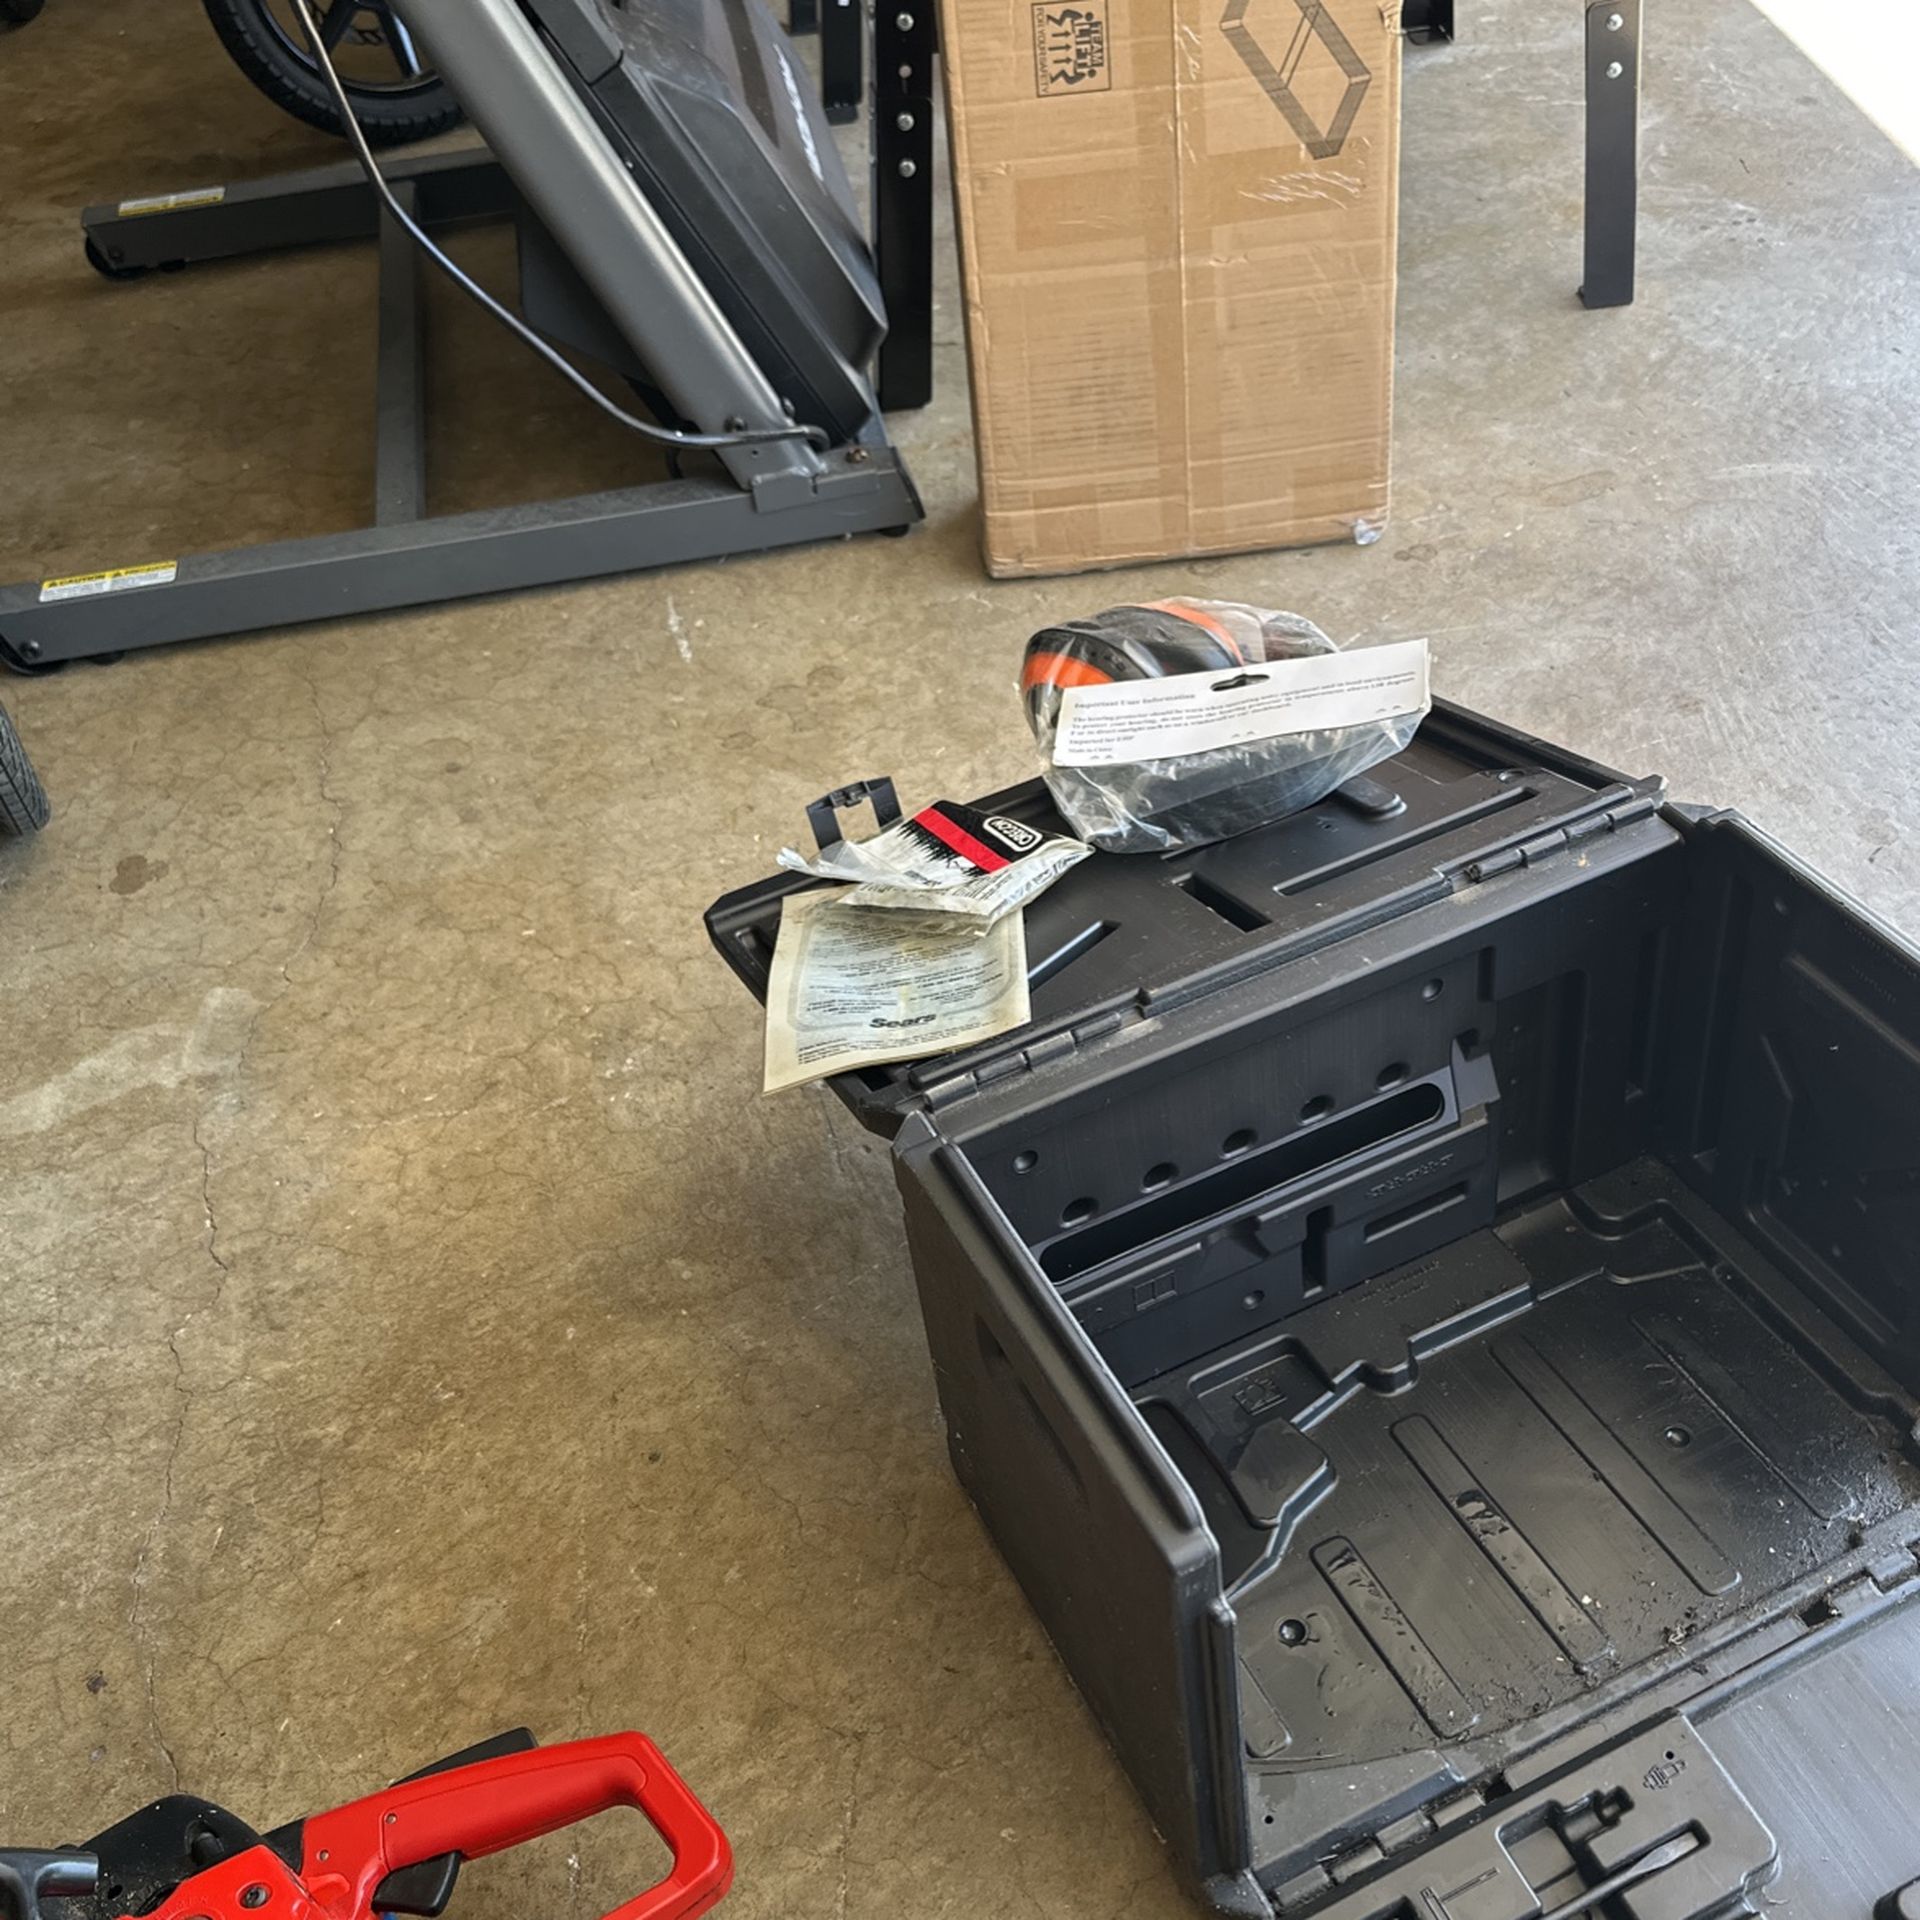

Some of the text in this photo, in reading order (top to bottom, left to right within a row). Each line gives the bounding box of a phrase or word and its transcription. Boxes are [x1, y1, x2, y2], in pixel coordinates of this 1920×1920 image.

[1036, 7, 1049, 93] FOR YOUR SAFETY
[1075, 25, 1091, 66] LIFT
[1091, 24, 1103, 65] TEAM
[990, 820, 1034, 846] OREGON
[868, 1013, 937, 1029] Sears
